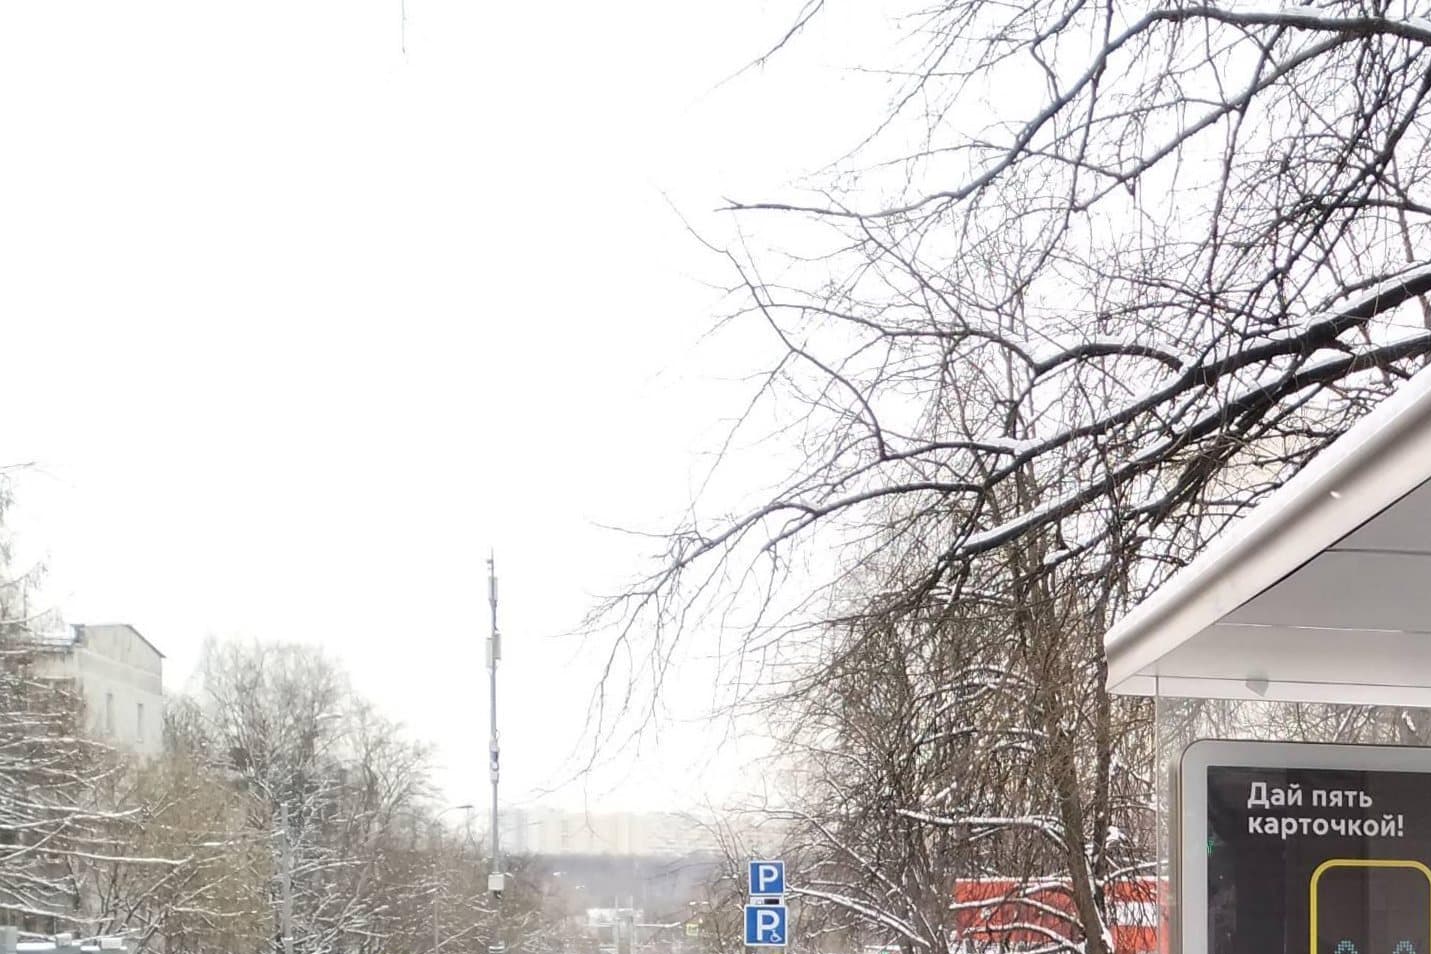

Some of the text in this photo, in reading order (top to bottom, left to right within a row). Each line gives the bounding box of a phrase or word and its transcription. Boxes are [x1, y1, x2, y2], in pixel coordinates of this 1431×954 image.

[1247, 781, 1373, 809] Дай пять
[1248, 814, 1404, 840] карточкой!
[759, 865, 779, 892] P
[757, 909, 780, 941] P
